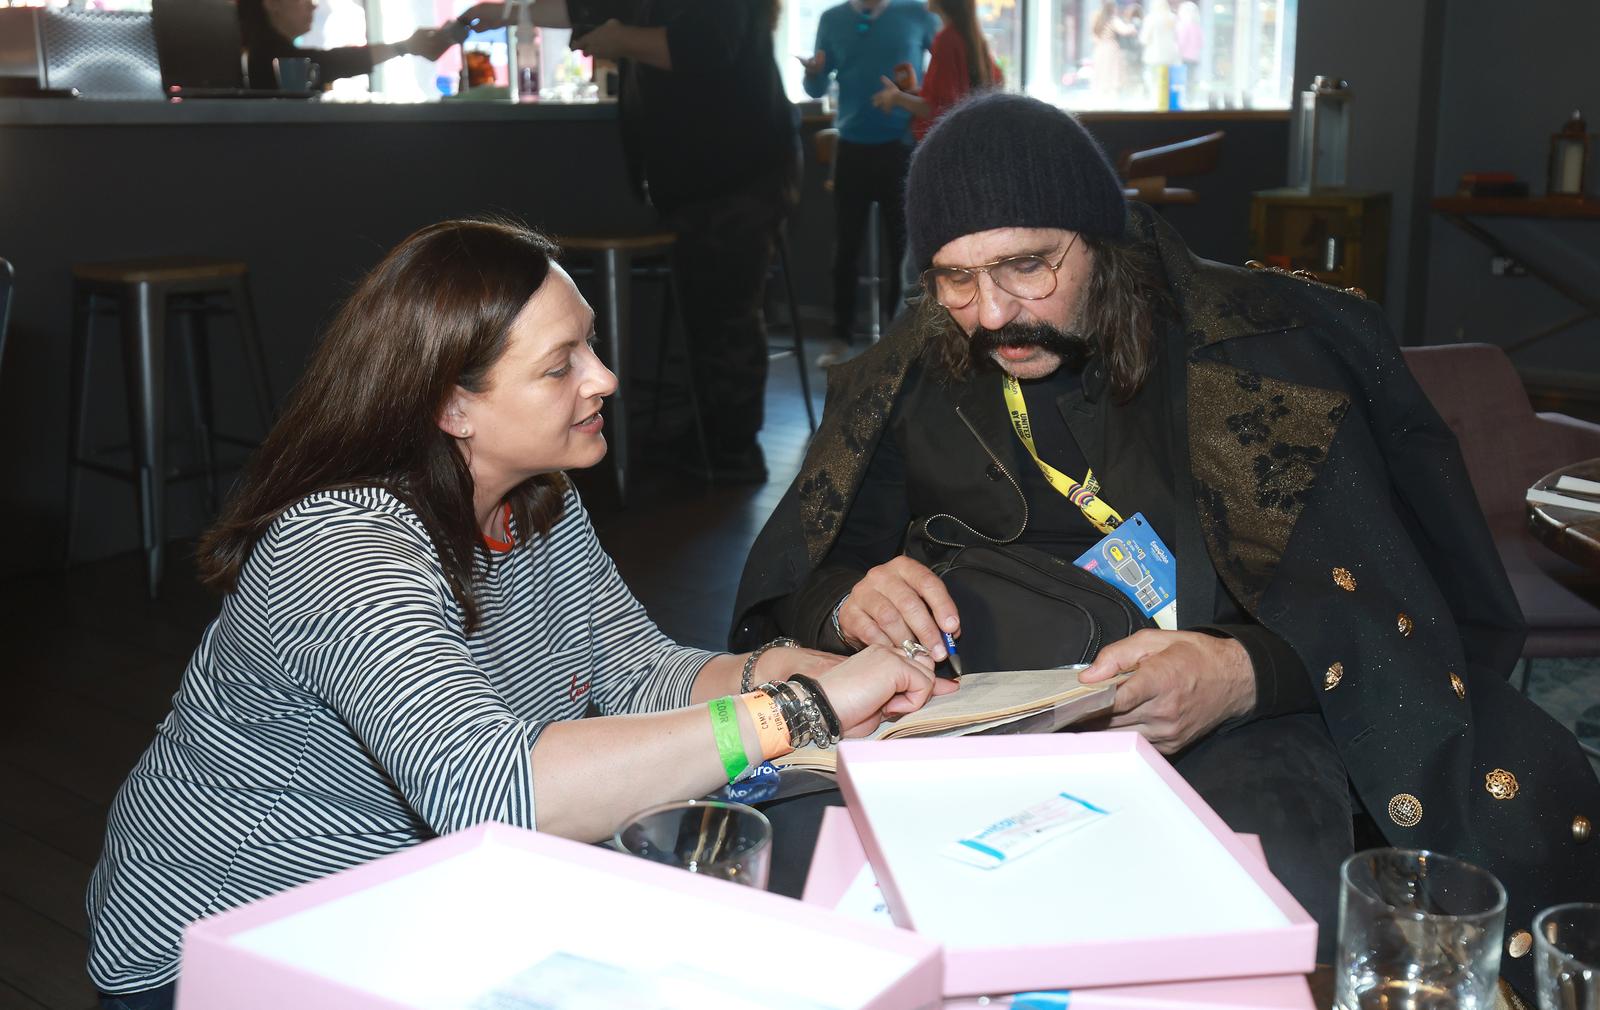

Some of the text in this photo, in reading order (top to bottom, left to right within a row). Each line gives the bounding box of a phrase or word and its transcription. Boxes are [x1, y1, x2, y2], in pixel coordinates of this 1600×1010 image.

[1011, 410, 1019, 420] BY
[1020, 413, 1031, 439] UNITED
[757, 712, 769, 730] CAMP
